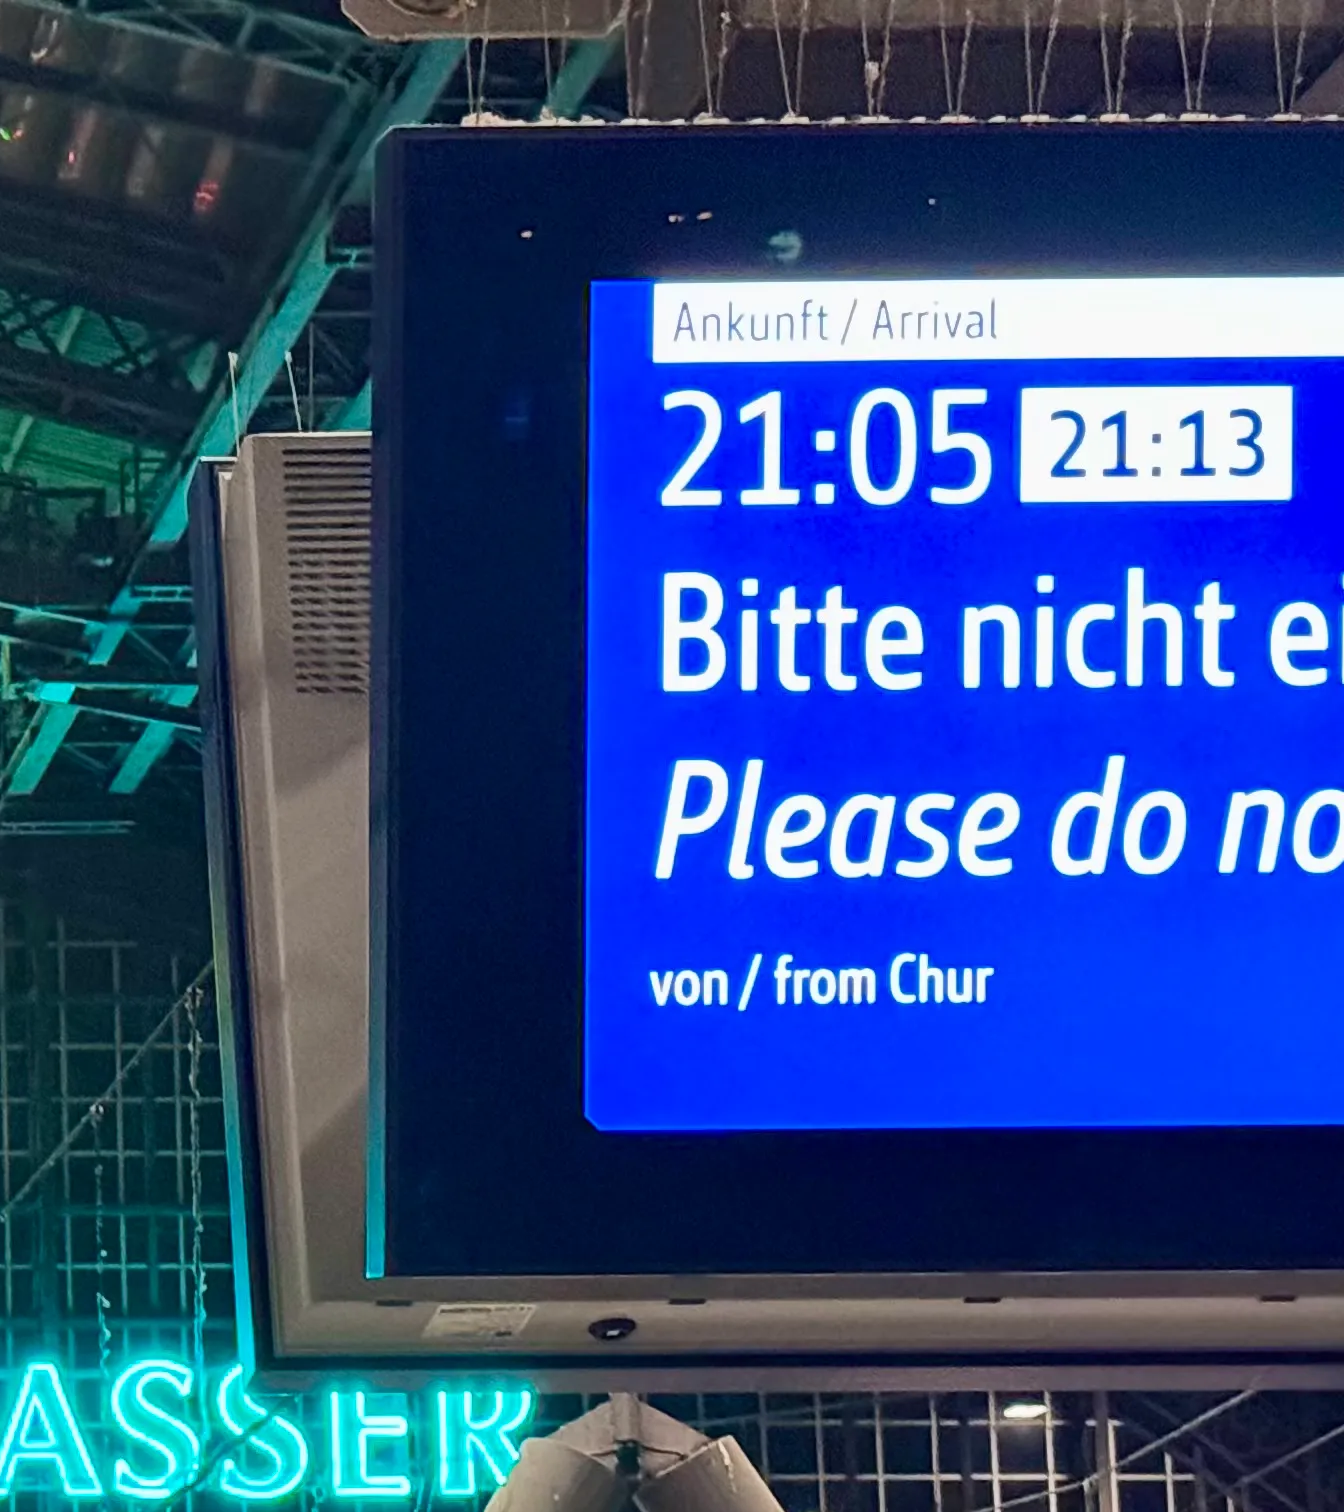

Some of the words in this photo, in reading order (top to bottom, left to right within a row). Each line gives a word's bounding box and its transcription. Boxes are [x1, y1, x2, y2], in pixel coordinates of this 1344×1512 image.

[673, 298, 829, 342] Ankunft
[839, 297, 859, 346] /
[871, 297, 998, 340] Arrival
[660, 386, 994, 508] 21:05
[1048, 409, 1267, 478] 21:13
[661, 570, 925, 693] Bitte
[962, 566, 1236, 690] nicht
[1269, 572, 1344, 688] e
[654, 758, 1021, 881] Please
[1050, 754, 1188, 878] do
[1216, 788, 1344, 875] no
[649, 968, 729, 1007] von
[737, 952, 764, 1012] /
[773, 953, 877, 1005] from
[889, 952, 995, 1004] Chur
